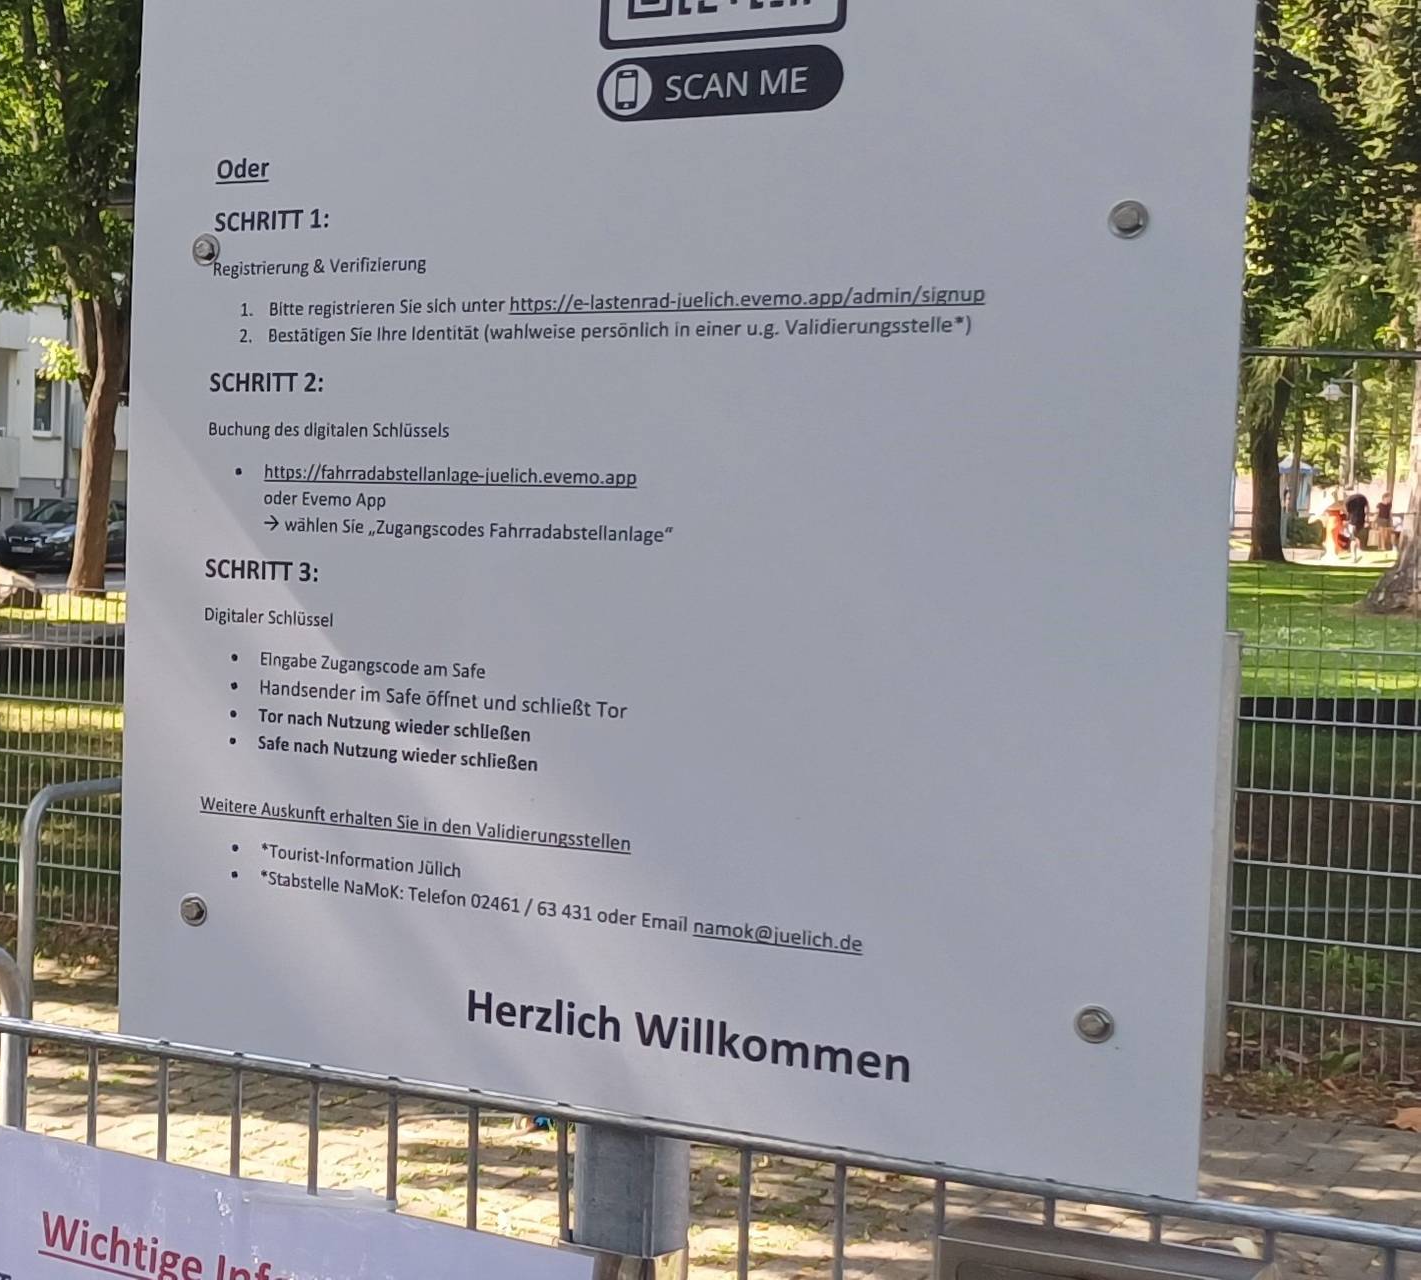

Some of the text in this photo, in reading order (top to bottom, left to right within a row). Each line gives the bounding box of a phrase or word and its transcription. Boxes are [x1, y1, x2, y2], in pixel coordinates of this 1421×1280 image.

[665, 66, 809, 102] SCAN ME
[215, 158, 270, 183] Oder
[214, 208, 330, 232] SCHRITT 1:
[212, 256, 426, 279] Registrierung & Verifizierung
[240, 287, 986, 319] 1. Bitte registrieren Sie sich unter https://e-lastenrad-juelich.evemo.app/admin/signup
[239, 329, 253, 344] 2.
[268, 328, 346, 346] Bestätigen
[349, 327, 372, 343] Sie
[377, 326, 407, 342] Ihre
[412, 325, 479, 341] Identität
[484, 324, 576, 343] (wahlweise
[580, 322, 670, 341] persönlich
[674, 322, 690, 337] in
[696, 320, 741, 336] einer
[747, 322, 779, 340] u.g.
[209, 373, 325, 392] SCHRITT 2:
[208, 422, 450, 440] Buchung des digitalen Schlüssels
[264, 462, 638, 488] https://fahrradabstellanlage-juelich.evemo.app
[264, 491, 387, 510] oder Evemo App
[284, 518, 338, 533] wählen
[342, 518, 364, 534] Sie
[205, 558, 319, 583] SCHRITT 3:
[204, 607, 334, 627] Digitaler Schlüssel
[260, 651, 486, 679] Eingabe Zugangscode am Safe
[259, 680, 629, 720] Handsender im Safe öffnet und schließt Tor
[259, 709, 531, 743] Tor nach Nutzung wieder schließen
[258, 735, 538, 772] Safe nach Nutzung wieder schließen
[200, 796, 632, 854] Weitere Auskunft erhalten Sie in den Validierungsstellen
[418, 860, 461, 879] Jülich
[344, 880, 406, 901] NaMoK:
[409, 887, 468, 908] Telefon
[471, 894, 521, 914] 02461
[524, 898, 534, 918] /
[536, 901, 558, 917] 63
[561, 904, 593, 922] 431
[597, 909, 637, 927] oder
[641, 912, 689, 934] Email
[692, 919, 864, 956] namok@juelich.de
[467, 988, 911, 1083] Herzlich Willkommen
[38, 1210, 203, 1280] Wichtige
